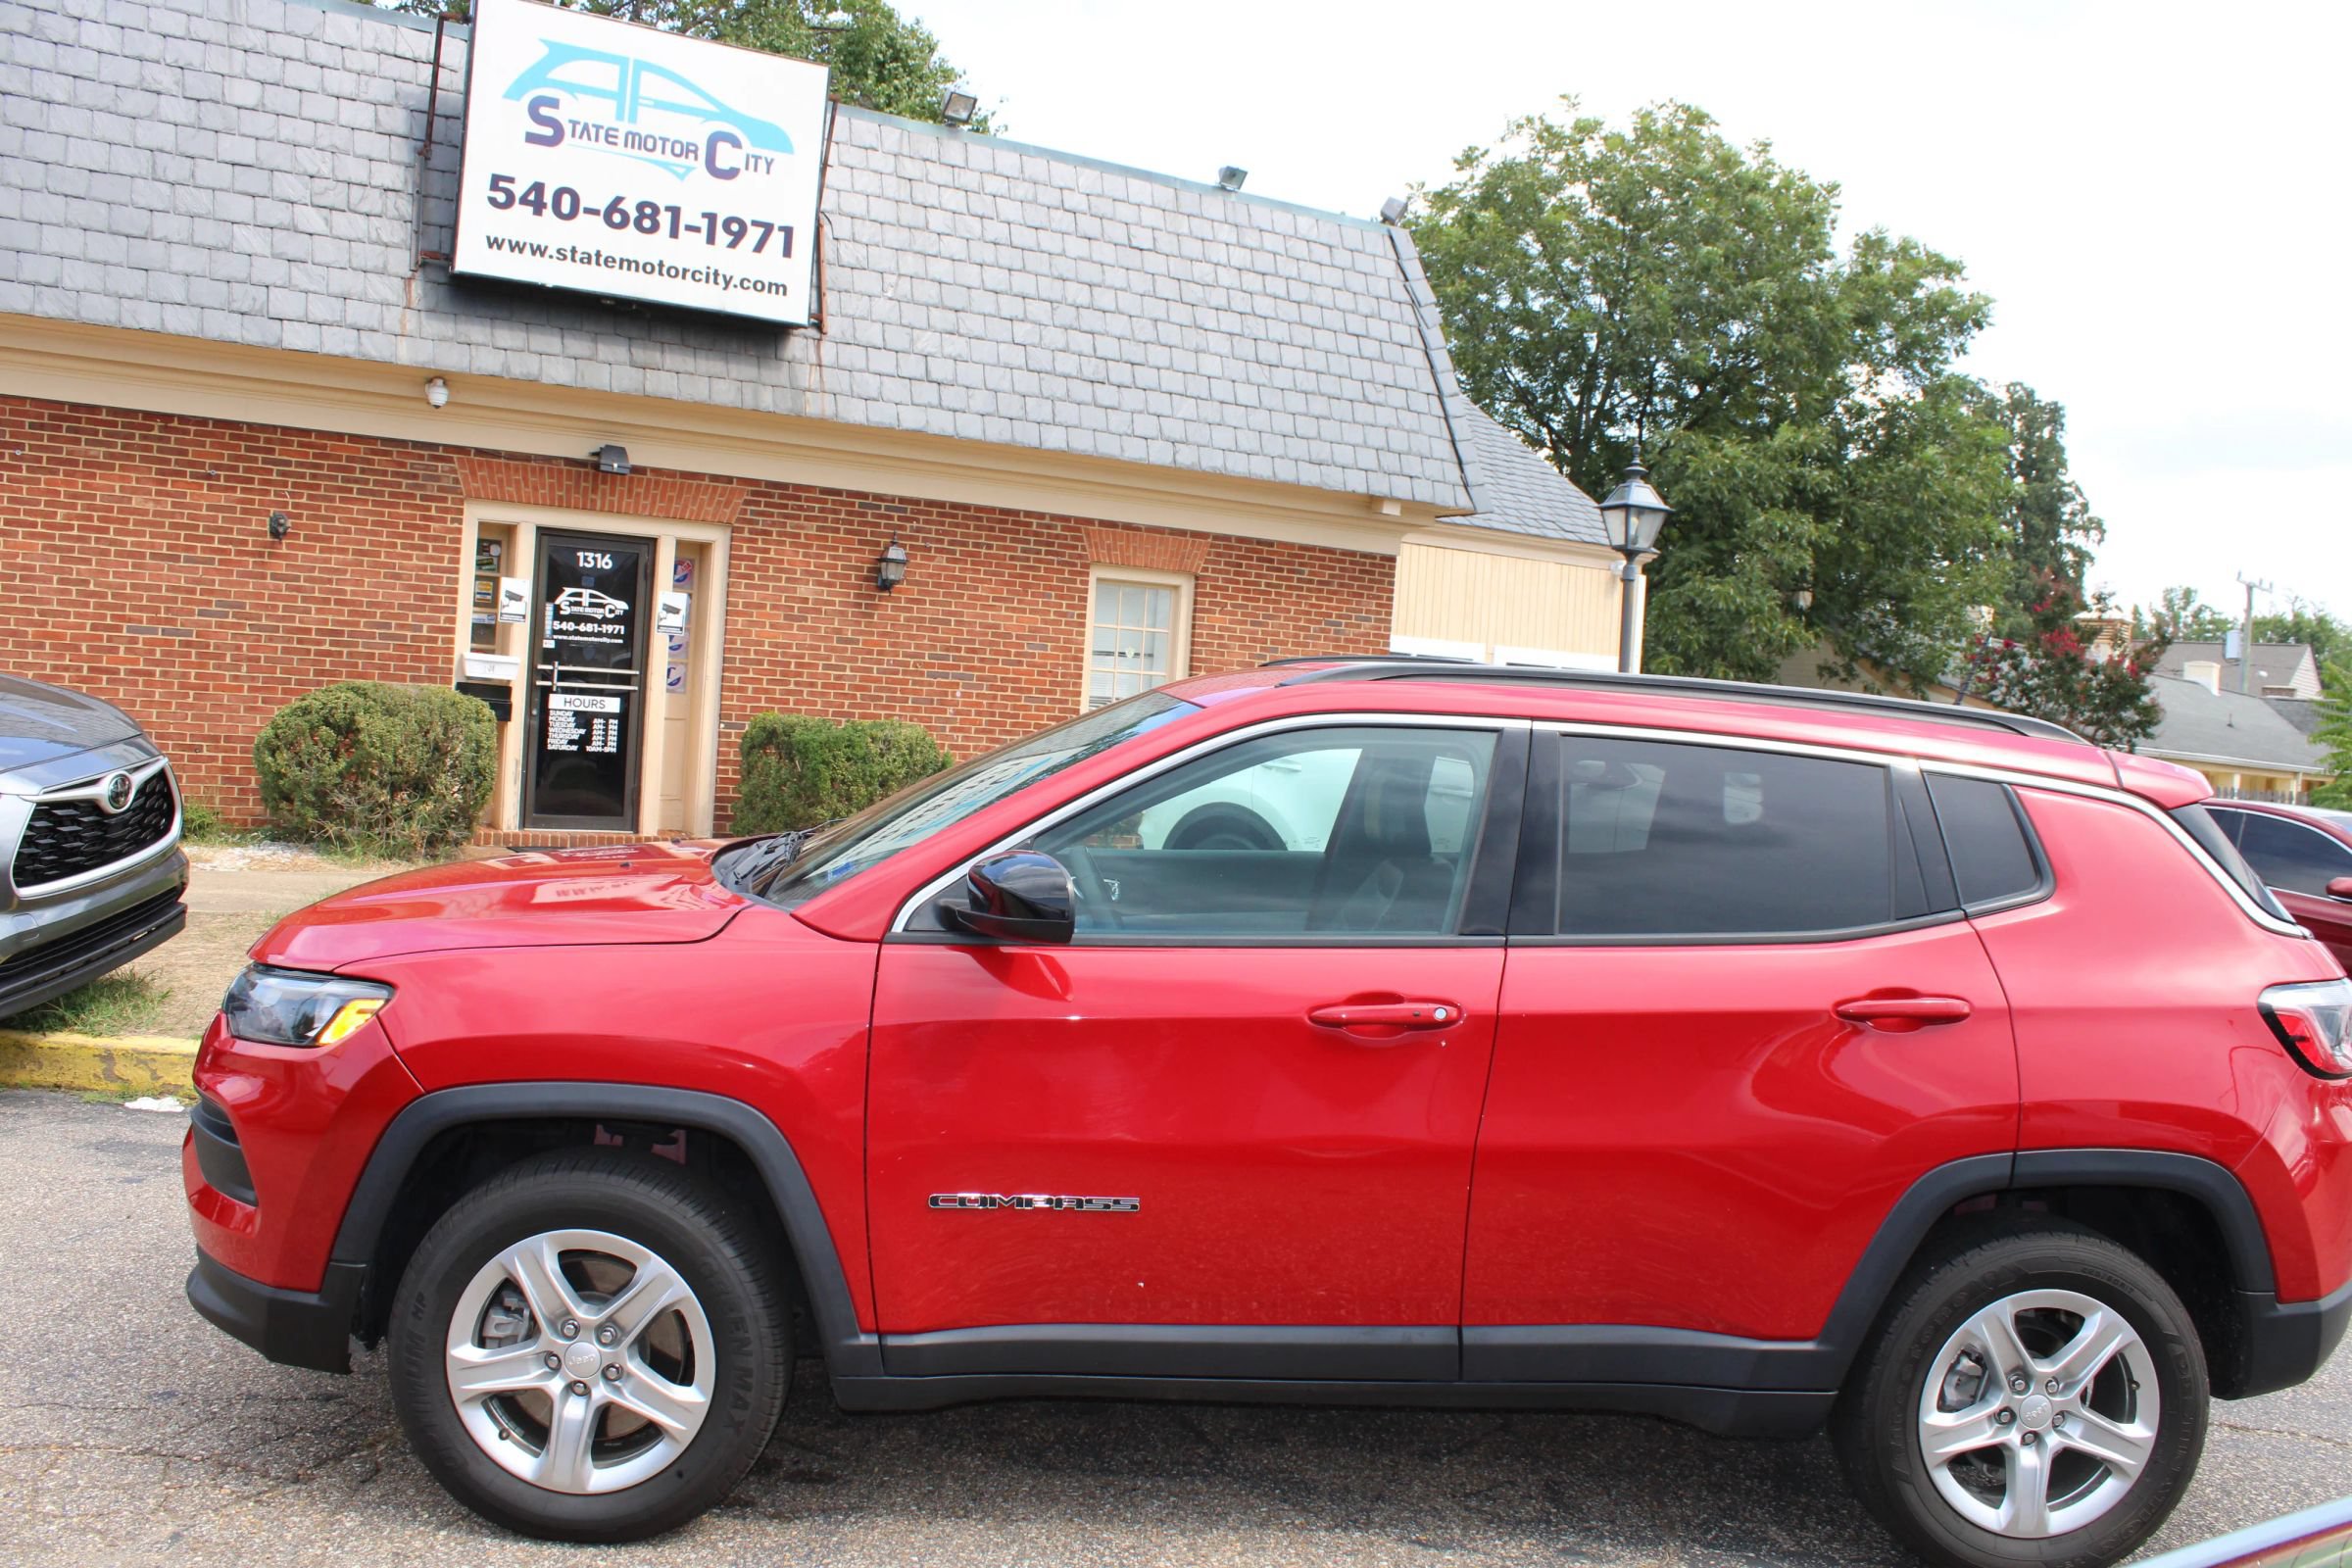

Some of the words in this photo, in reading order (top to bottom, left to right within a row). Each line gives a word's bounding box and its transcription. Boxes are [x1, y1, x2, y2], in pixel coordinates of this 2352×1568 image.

[524, 95, 619, 148] STATE
[624, 131, 699, 162] MOTOR
[705, 130, 775, 180] CITY
[486, 172, 795, 259] 540-681-1971
[485, 234, 789, 297] www.statemotorcity.com
[576, 551, 613, 570] 1316
[553, 620, 625, 635] 540-681-1971
[553, 634, 624, 644] www.statemotorcity.com
[564, 697, 607, 710] HOURS
[928, 1193, 1141, 1212] COMPASS
